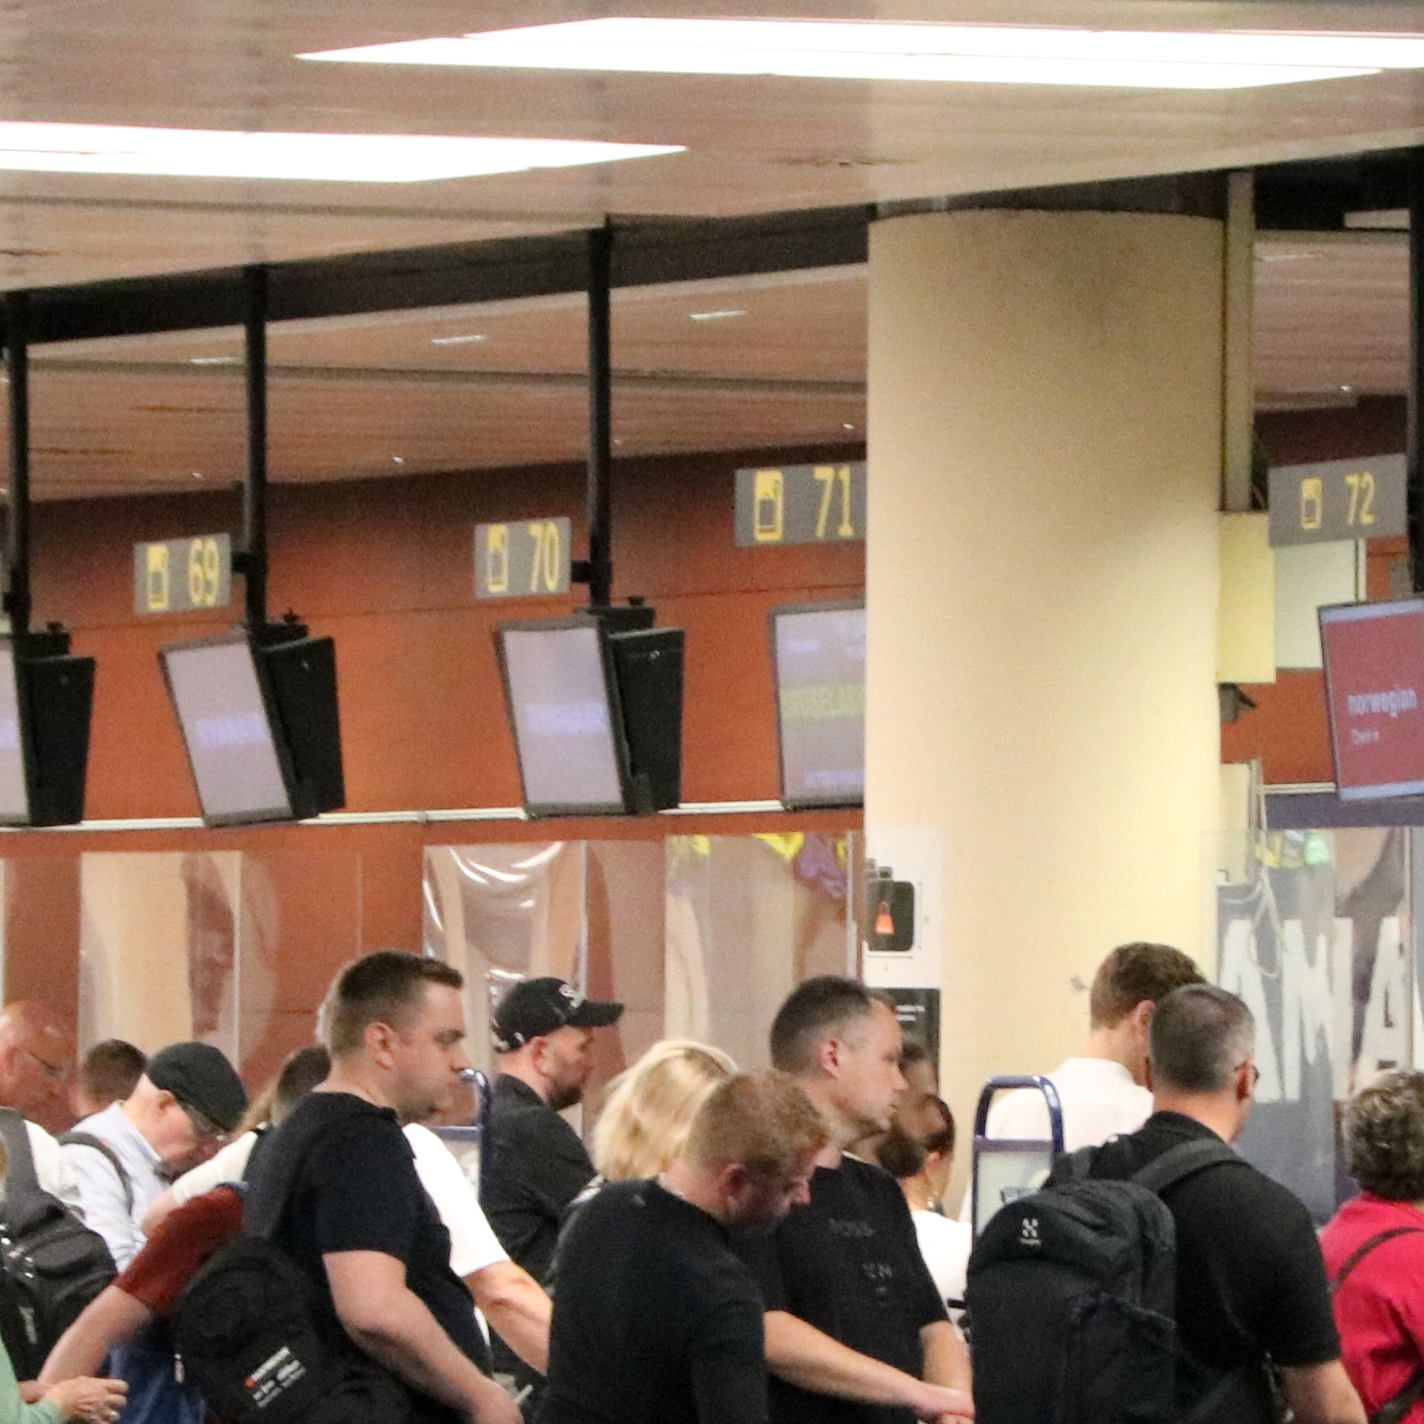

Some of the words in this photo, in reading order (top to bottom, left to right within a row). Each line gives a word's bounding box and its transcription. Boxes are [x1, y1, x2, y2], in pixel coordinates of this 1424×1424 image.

[813, 466, 853, 538] 71
[1345, 472, 1375, 527] 72
[189, 538, 220, 606] 69
[528, 521, 560, 592] 70
[1348, 684, 1417, 718] norwegian
